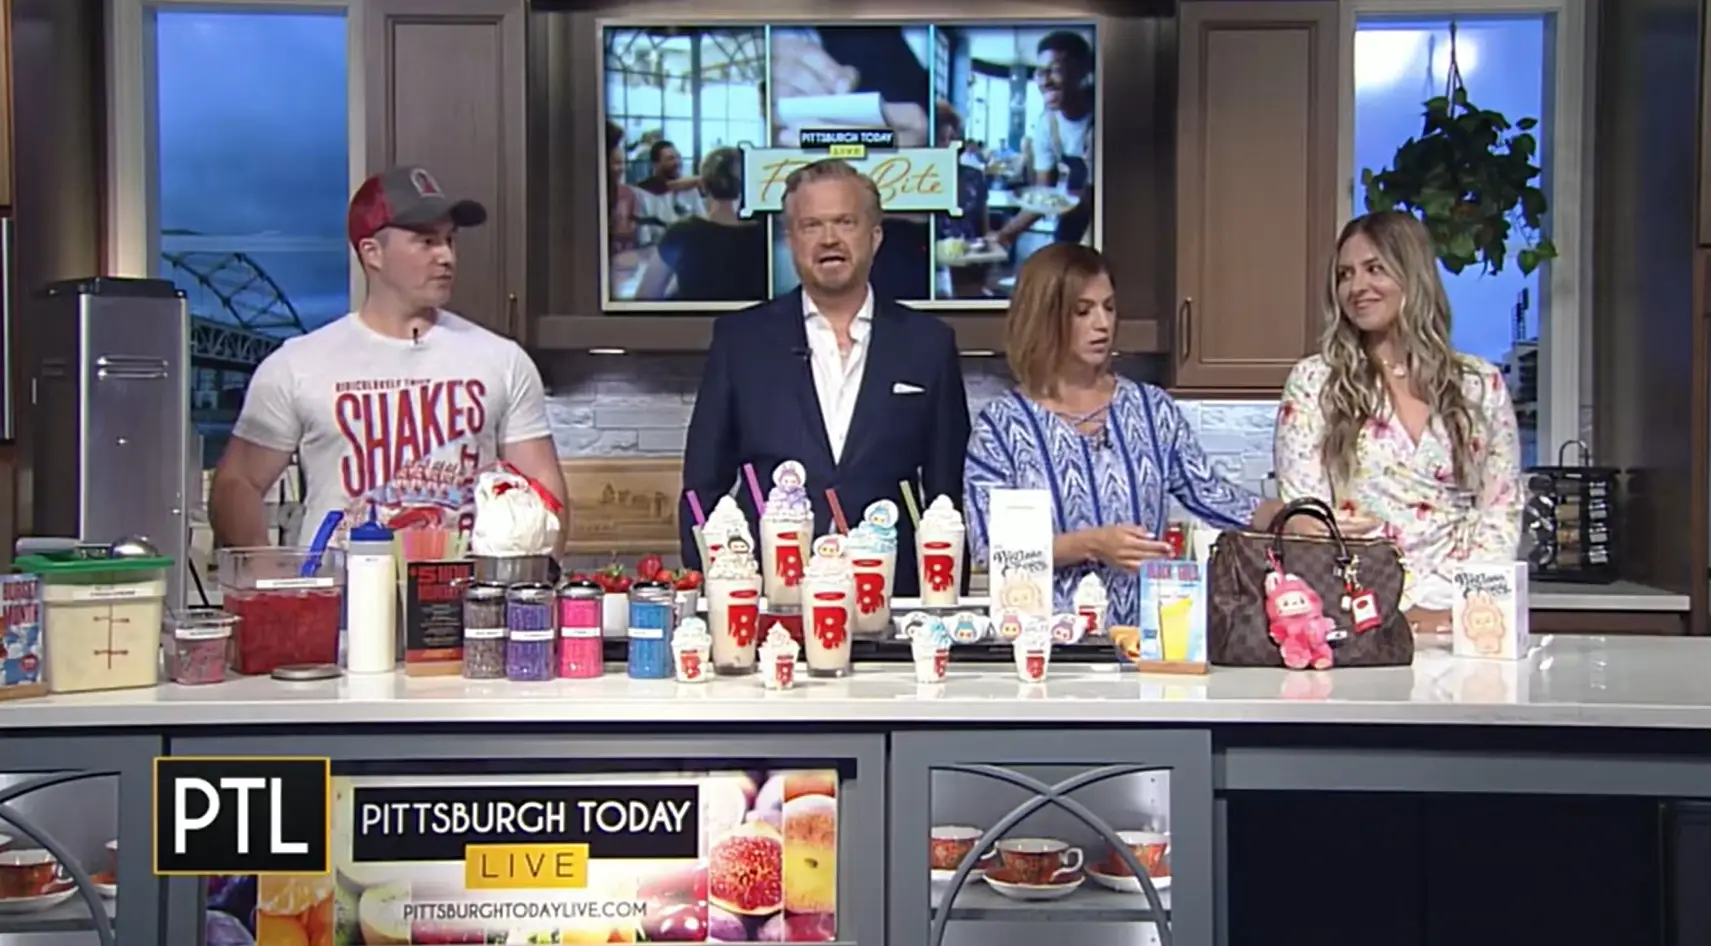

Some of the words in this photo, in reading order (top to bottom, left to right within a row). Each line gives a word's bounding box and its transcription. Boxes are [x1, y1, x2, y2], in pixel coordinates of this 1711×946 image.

[802, 132, 859, 144] PITTSBURGH
[860, 132, 893, 144] TODAY
[832, 147, 862, 156] LIVE
[866, 157, 944, 202] Bite
[335, 379, 486, 498] SHAKES
[361, 800, 567, 835] PITTSBURGH
[577, 800, 691, 833] TODAY
[481, 852, 575, 879] LIVE
[403, 901, 647, 921] PITTSBURGHTODAYLIVE.COM
